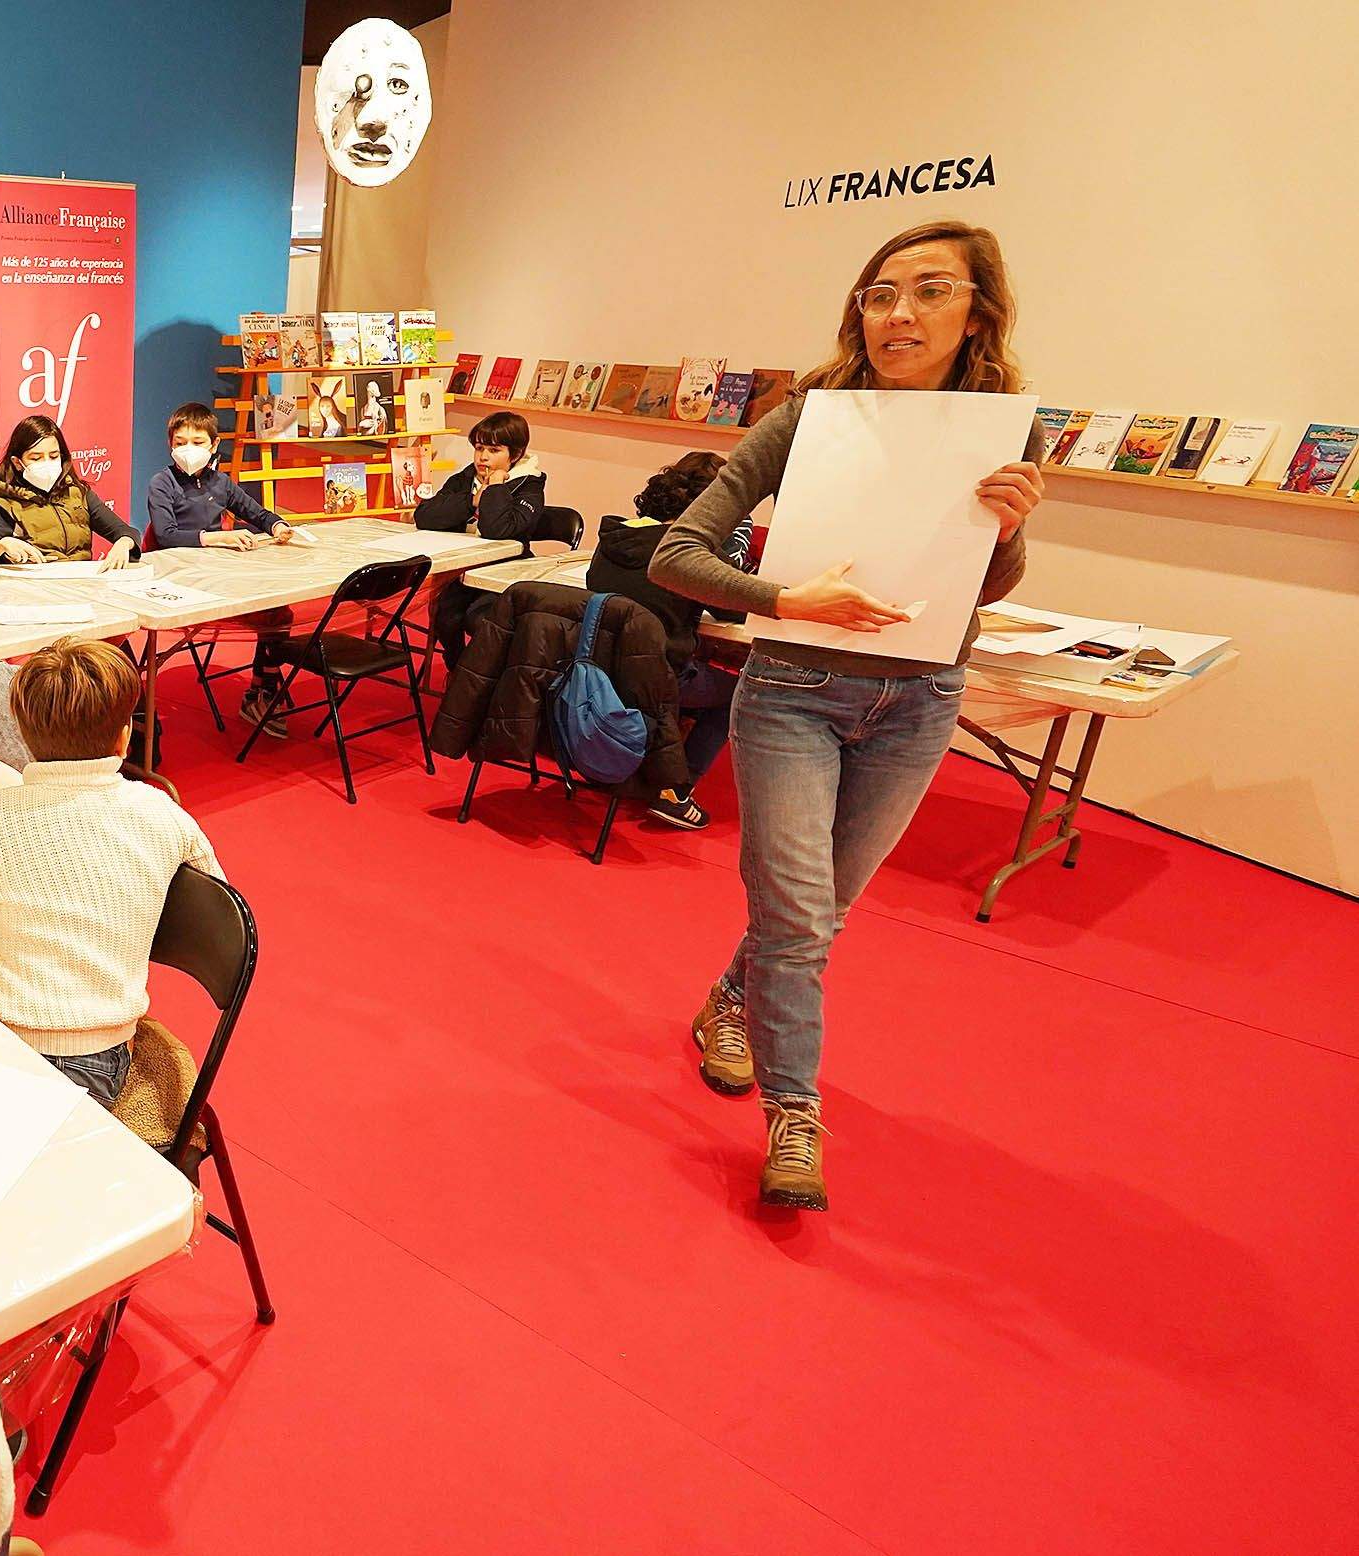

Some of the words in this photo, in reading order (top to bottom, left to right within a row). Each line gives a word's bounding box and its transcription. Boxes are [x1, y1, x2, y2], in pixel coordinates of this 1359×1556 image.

[784, 177, 823, 208] LIX
[827, 154, 996, 204] FRANCESA
[2, 256, 20, 267] Más
[21, 257, 31, 267] de
[34, 257, 48, 268] 125
[50, 258, 69, 268] años
[70, 257, 81, 267] de
[81, 258, 124, 270] experiencia
[2, 275, 13, 284] en
[14, 272, 22, 283] la
[23, 272, 75, 284] enseñanza
[77, 273, 90, 284] del
[91, 271, 124, 284] francés
[71, 445, 107, 461] ançaise
[79, 458, 112, 482] Vigo
